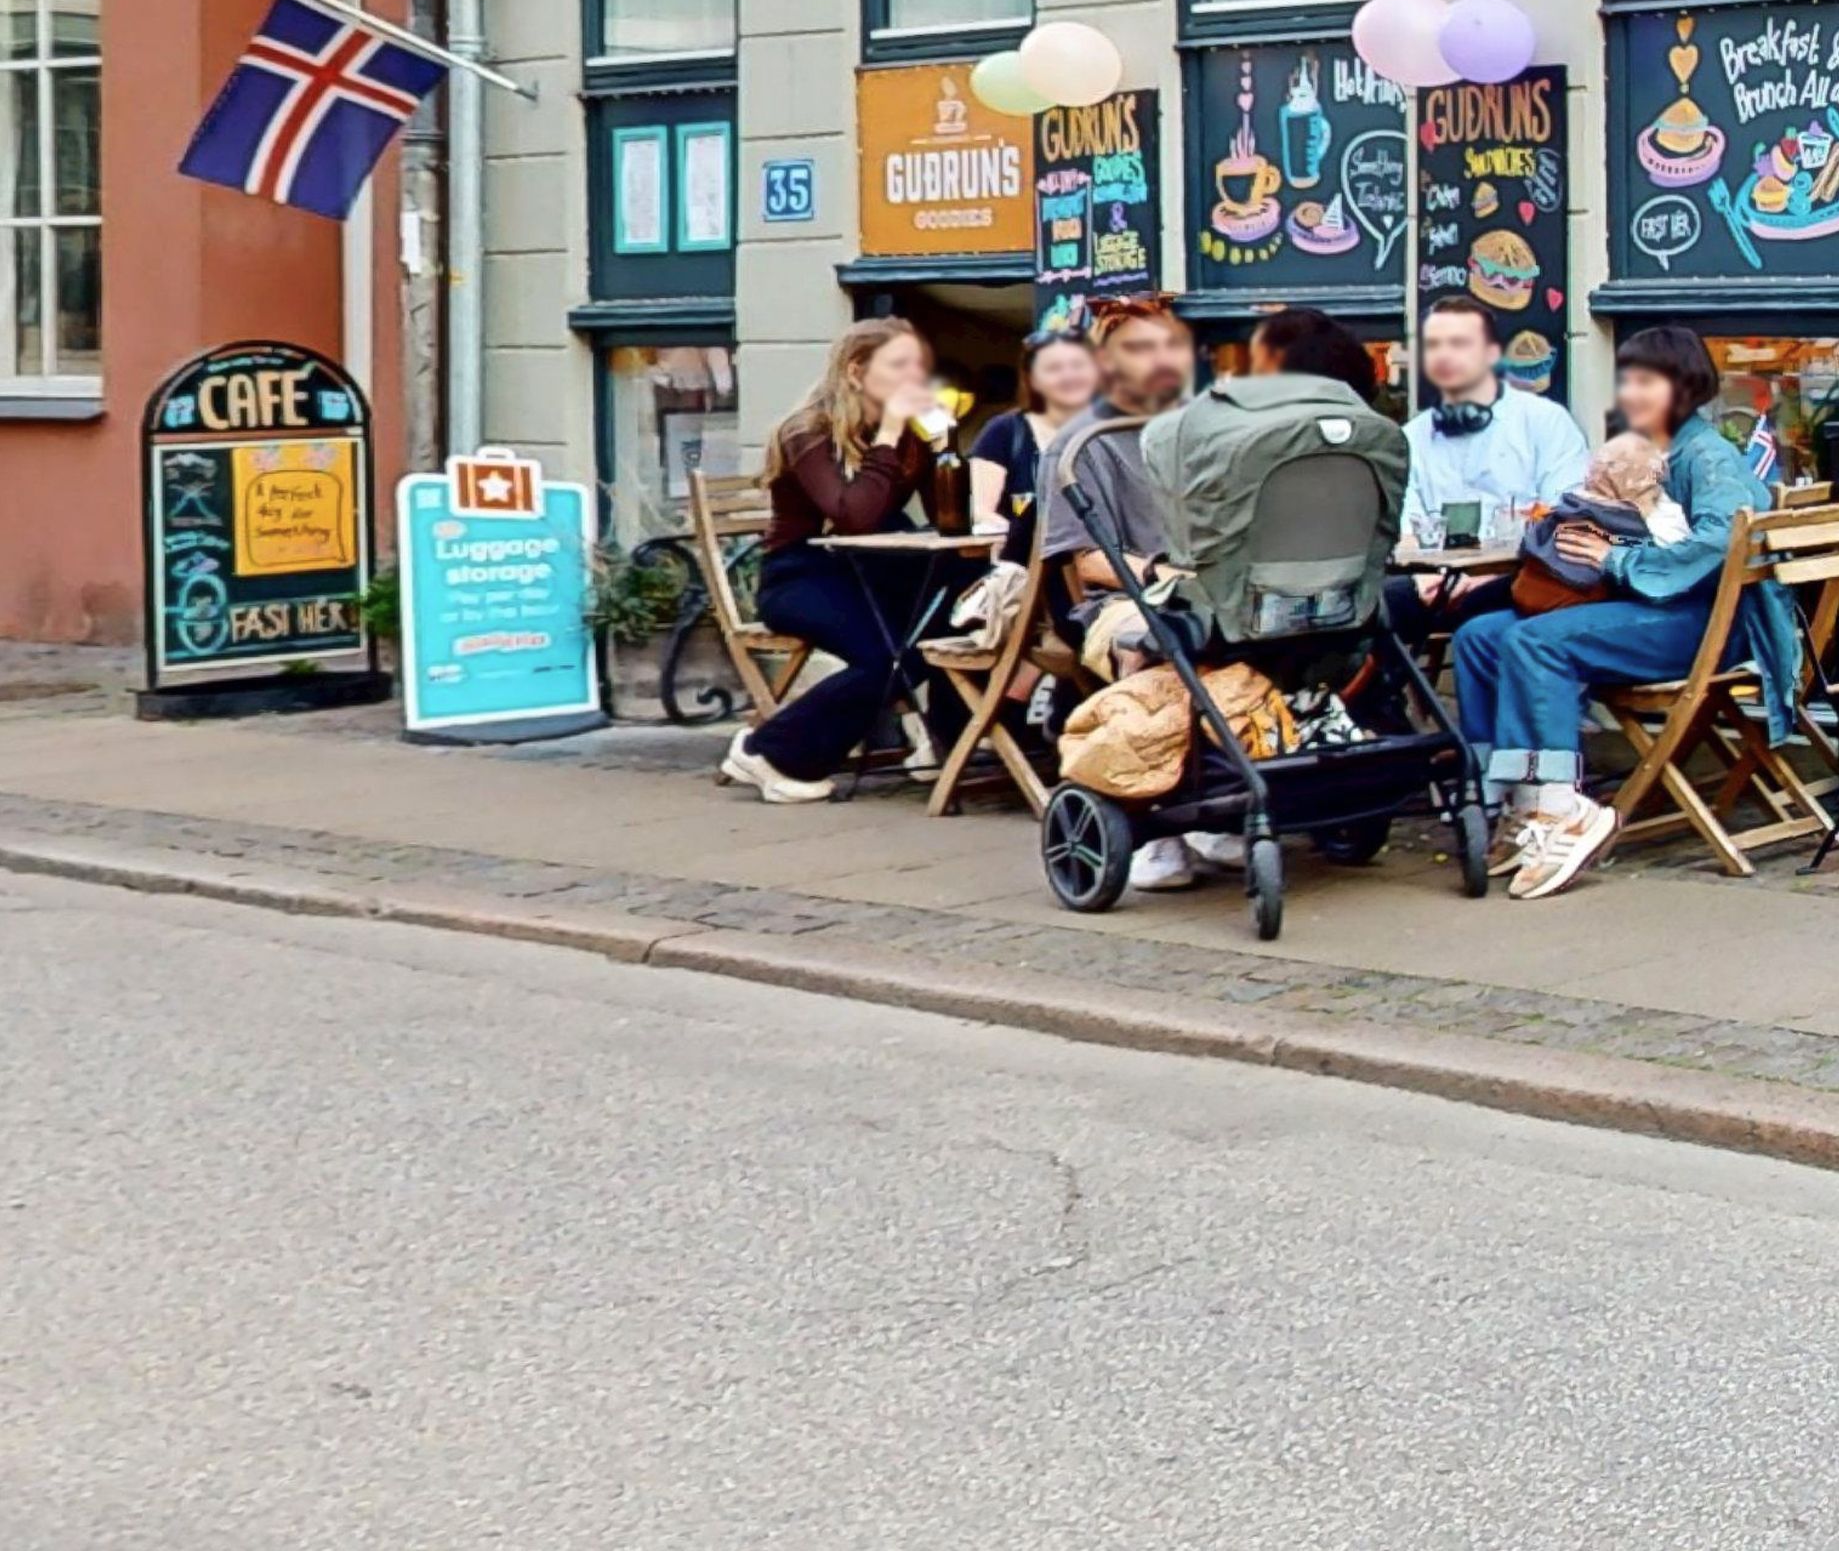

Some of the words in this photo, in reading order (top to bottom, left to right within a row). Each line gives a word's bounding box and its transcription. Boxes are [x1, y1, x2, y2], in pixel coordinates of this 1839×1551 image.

[1720, 17, 1820, 85] Breakfast
[1734, 68, 1797, 124] Brunch
[1799, 69, 1831, 109] All
[769, 169, 809, 213] 35
[435, 537, 560, 563] Luggage
[446, 562, 551, 586] storage
